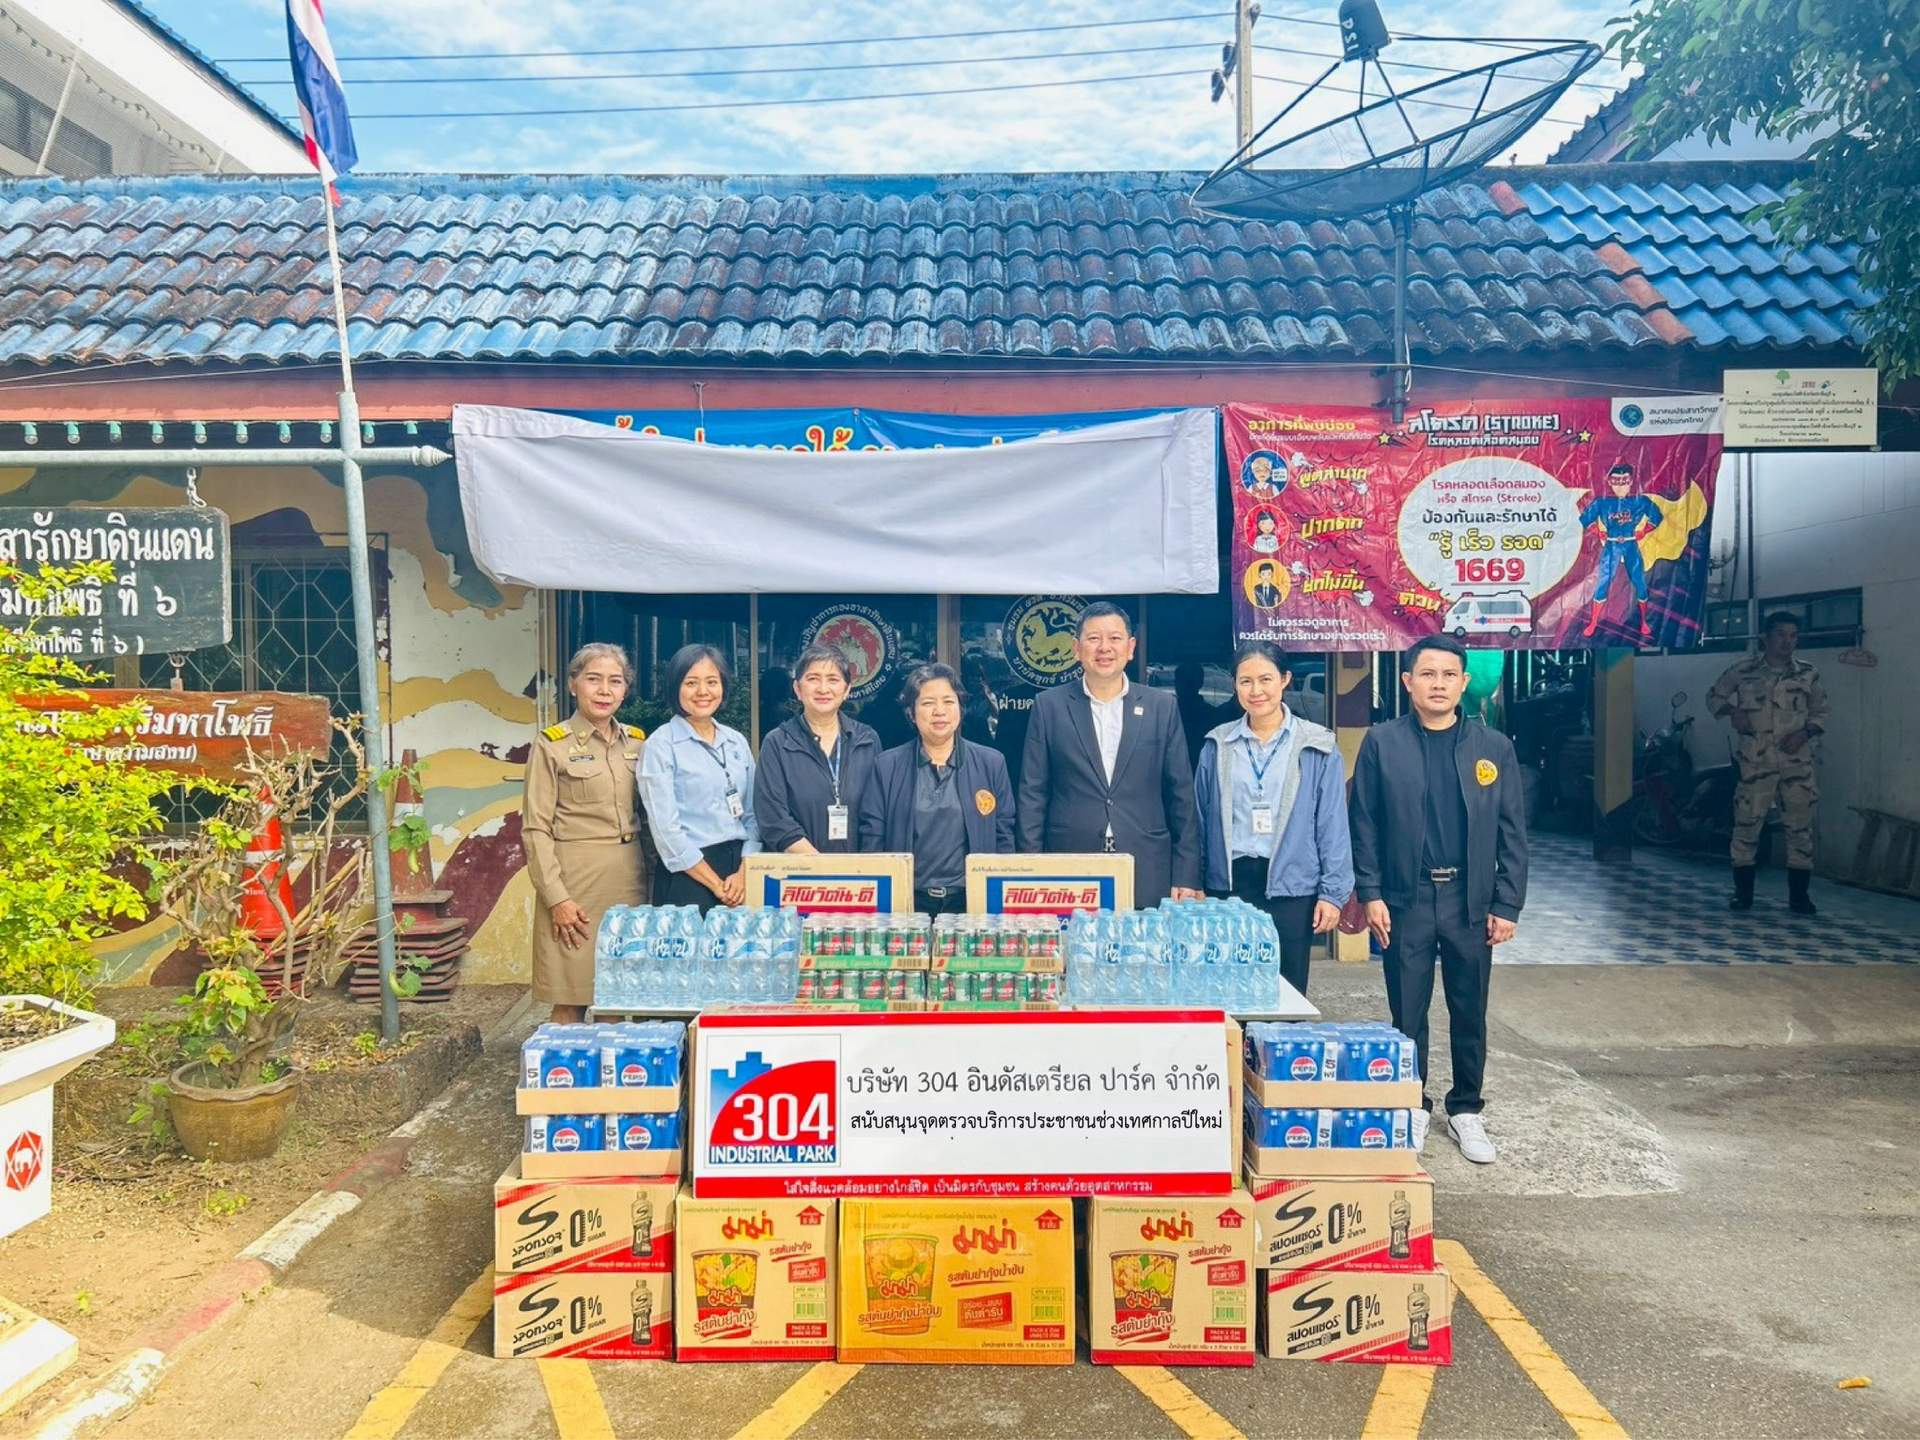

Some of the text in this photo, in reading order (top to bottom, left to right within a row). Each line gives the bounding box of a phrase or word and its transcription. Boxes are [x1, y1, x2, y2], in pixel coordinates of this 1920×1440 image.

[1432, 478, 1546, 490] โรคหลอดเลือดสมอง
[1437, 492, 1457, 504] หรือ
[1496, 492, 1542, 505] (Stroke)
[1422, 507, 1557, 525] ป้องกันและรักษาได้
[1459, 528, 1494, 551] เร็ว
[1454, 558, 1526, 583] 1669
[118, 561, 138, 616] ที่
[154, 585, 177, 616] ๖
[846, 1065, 1221, 1095] บริษัท 304 อินดัสเตรียล ปาร์ค จำกัด
[733, 1093, 834, 1142] 304
[850, 1109, 1223, 1136] สนับสนุนจุดตรวจบริการประชาชนช่วงเทศกาลปีใหม่
[711, 1146, 835, 1164] INDUSTRIAL PARK
[721, 1210, 774, 1240] มาม่า
[953, 1218, 1017, 1254] มาม่า
[1140, 1212, 1194, 1241] มาม่า
[512, 1232, 562, 1257] SPONSOR
[513, 1319, 563, 1344] SPONSOR
